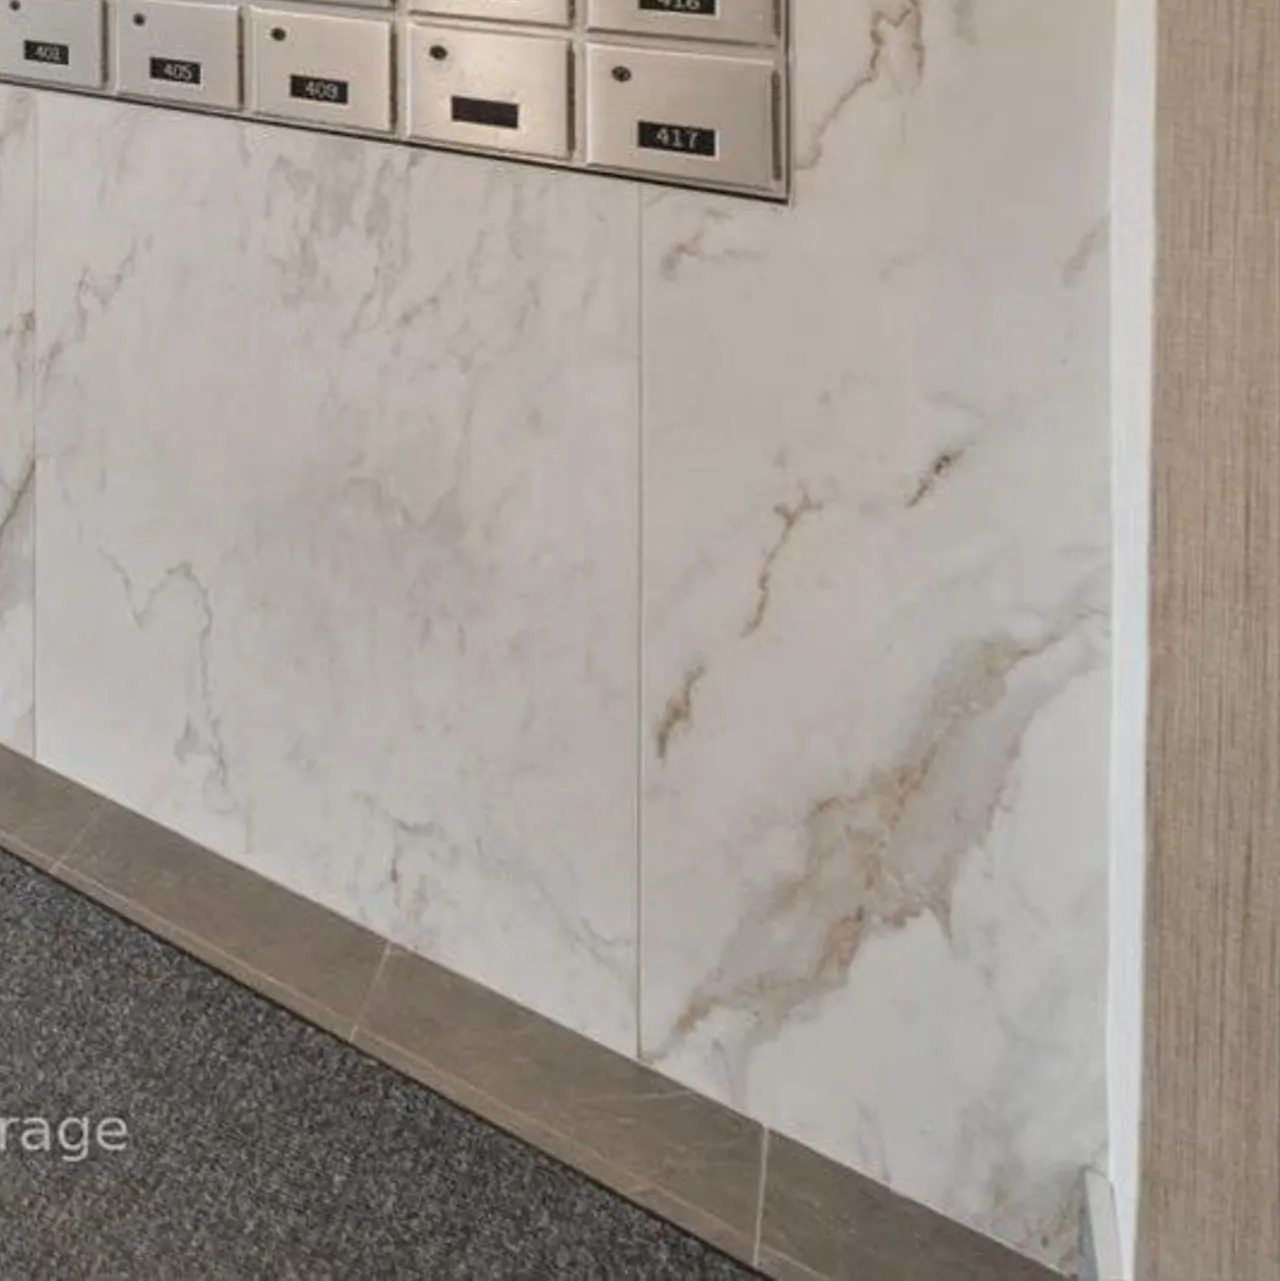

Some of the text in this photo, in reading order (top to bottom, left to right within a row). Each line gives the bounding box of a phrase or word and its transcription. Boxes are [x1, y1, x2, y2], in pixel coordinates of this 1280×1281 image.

[163, 62, 193, 80] 405
[305, 81, 340, 100] 409
[656, 128, 699, 148] 417
